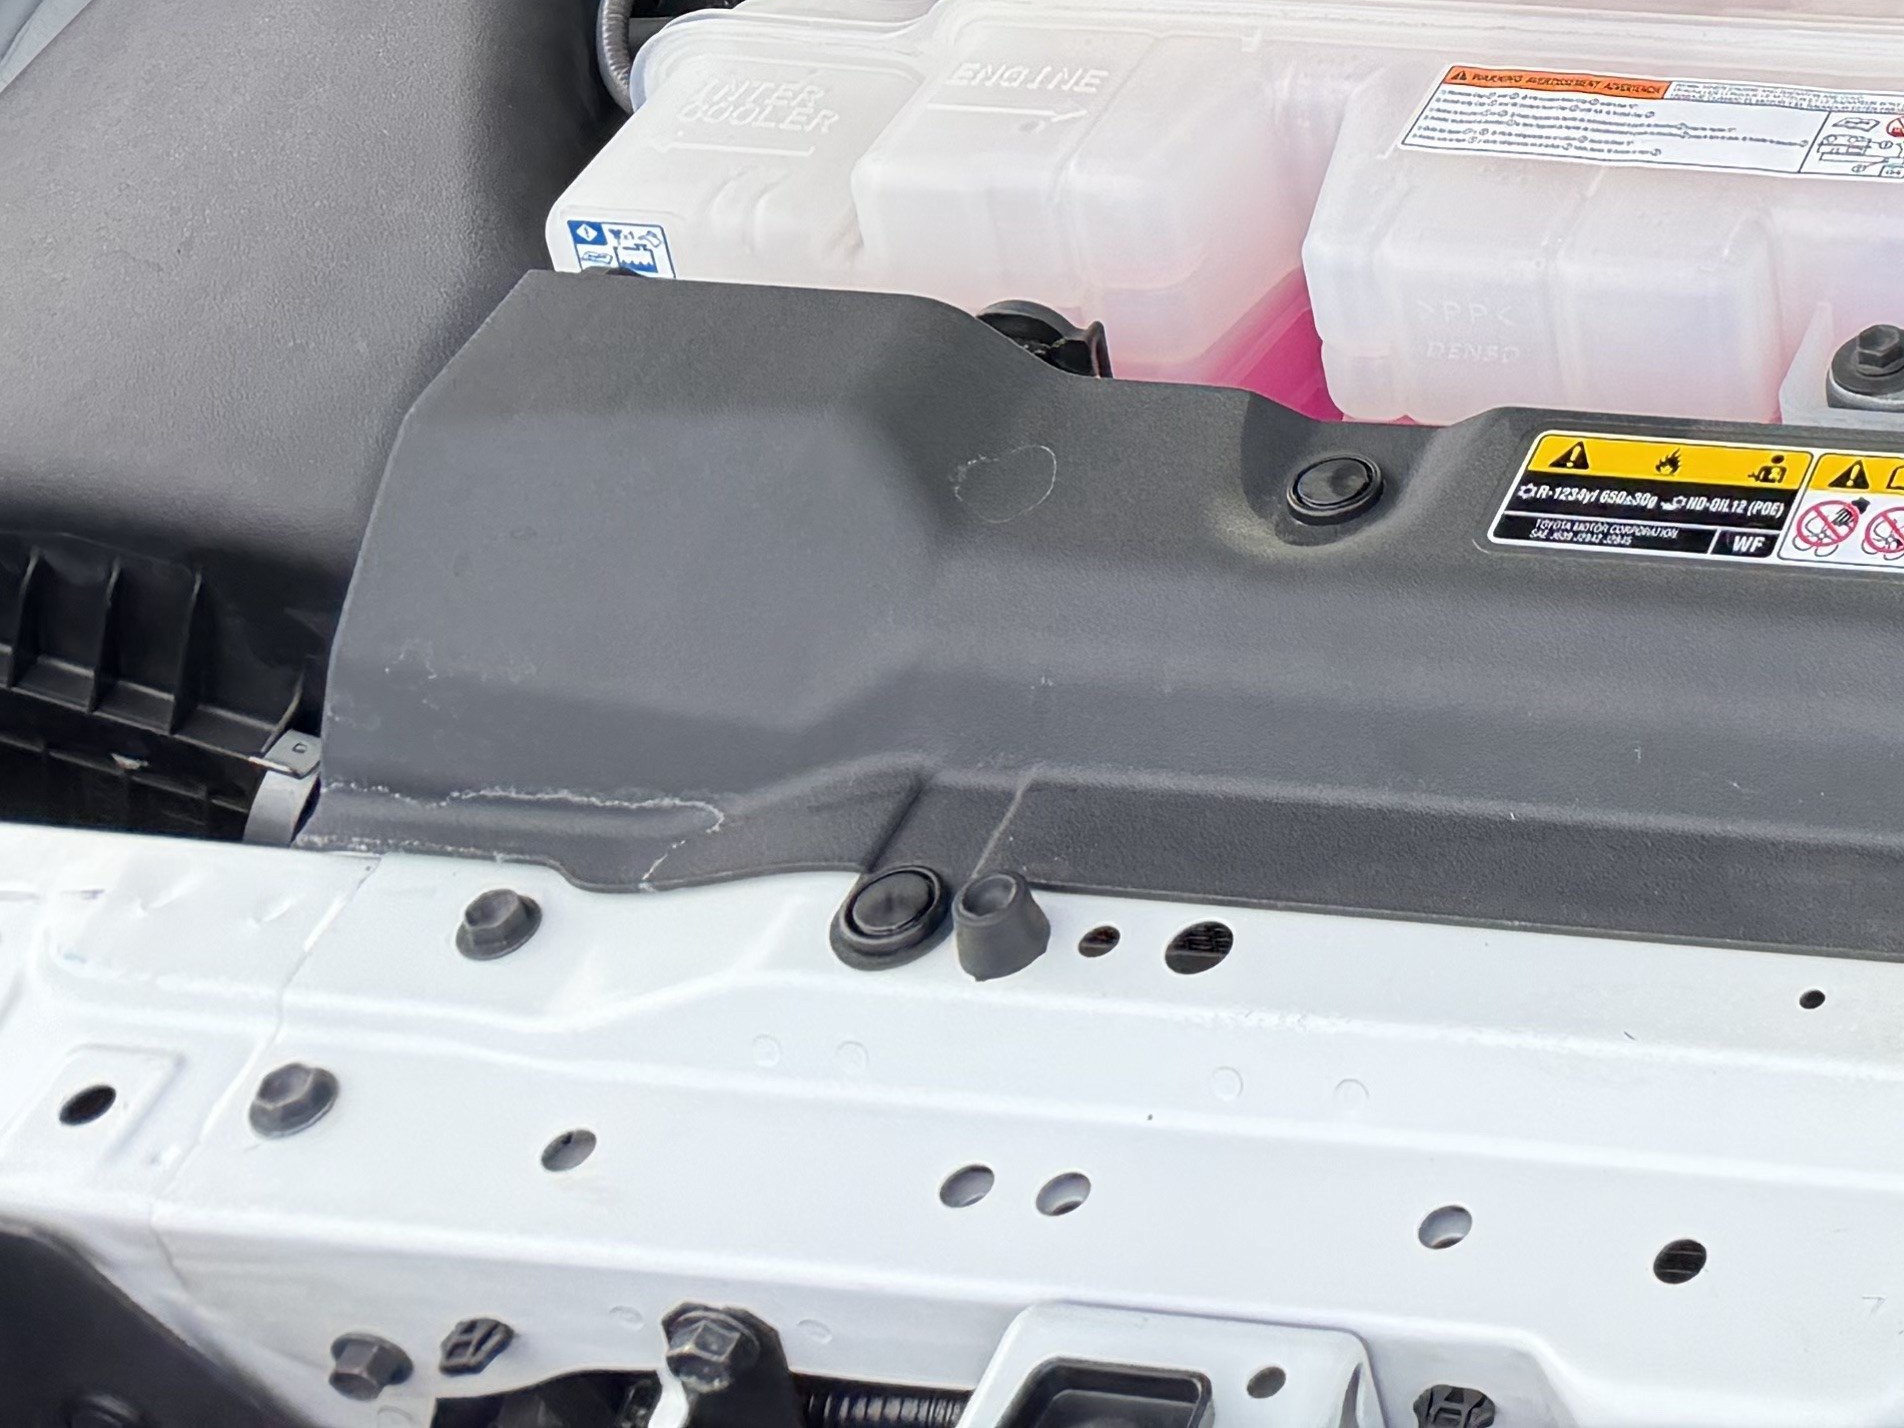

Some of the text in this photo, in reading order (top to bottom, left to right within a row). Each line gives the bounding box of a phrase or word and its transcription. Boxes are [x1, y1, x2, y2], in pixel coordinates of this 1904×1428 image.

[946, 62, 1109, 95] ENGINE
[698, 77, 825, 108] INTER
[676, 100, 841, 134] COOLER
[1426, 342, 1520, 364] DENSO
[1536, 484, 1598, 502] R-1234yf
[1746, 499, 1785, 519] (POE)
[1529, 528, 1550, 539] SAE
[1535, 518, 1680, 539] TOYOTA MOTOR CORPORATION
[1732, 535, 1766, 553] WF
